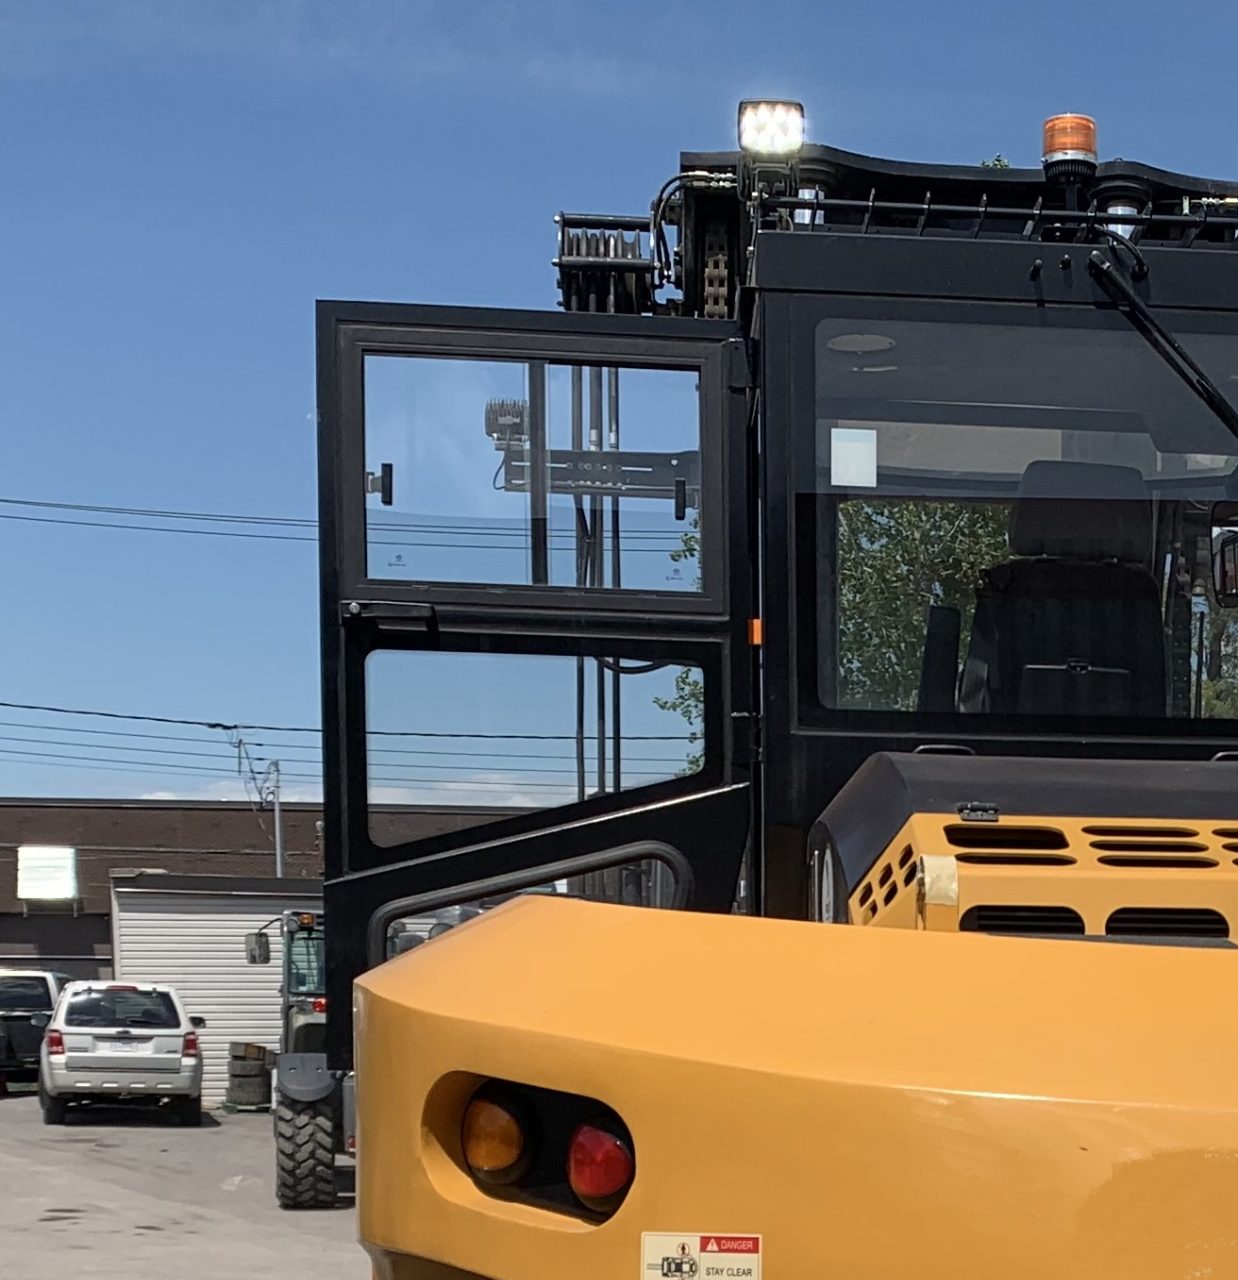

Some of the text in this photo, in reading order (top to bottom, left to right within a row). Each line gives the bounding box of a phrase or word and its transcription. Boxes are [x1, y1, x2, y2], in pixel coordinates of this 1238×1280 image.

[720, 1239, 753, 1250] DANGER
[705, 1267, 752, 1277] STAY CLEAR
